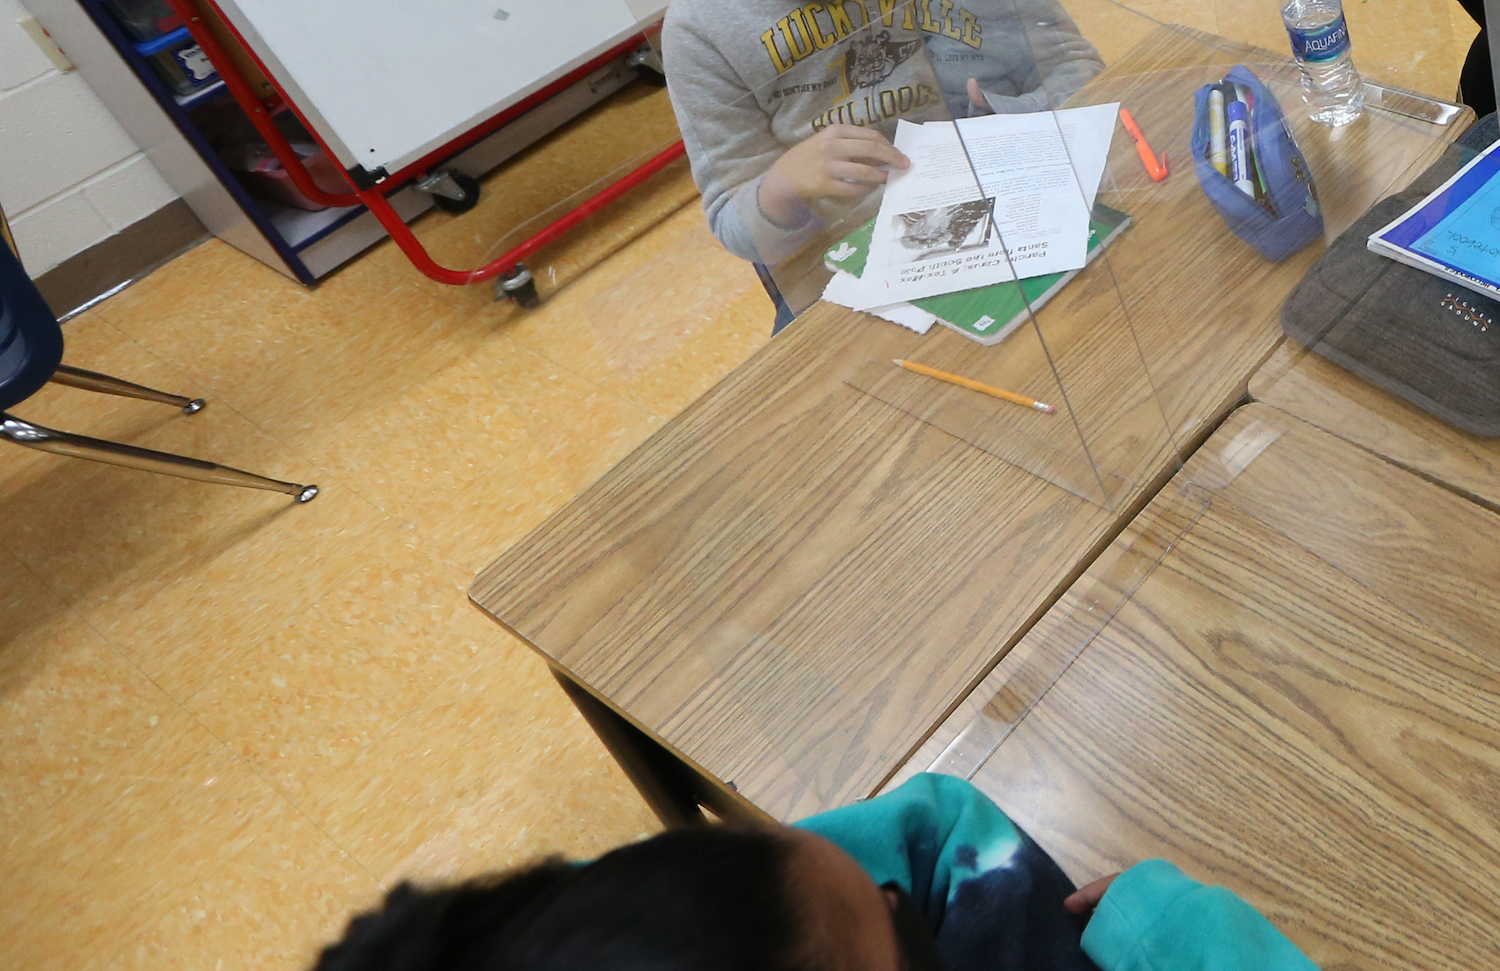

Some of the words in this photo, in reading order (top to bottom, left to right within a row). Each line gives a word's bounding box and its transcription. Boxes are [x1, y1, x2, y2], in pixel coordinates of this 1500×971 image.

[1017, 241, 1049, 252] Santa
[965, 254, 985, 263] the
[988, 248, 1014, 259] from
[1004, 250, 1047, 263] Pancho
[928, 257, 963, 271] South
